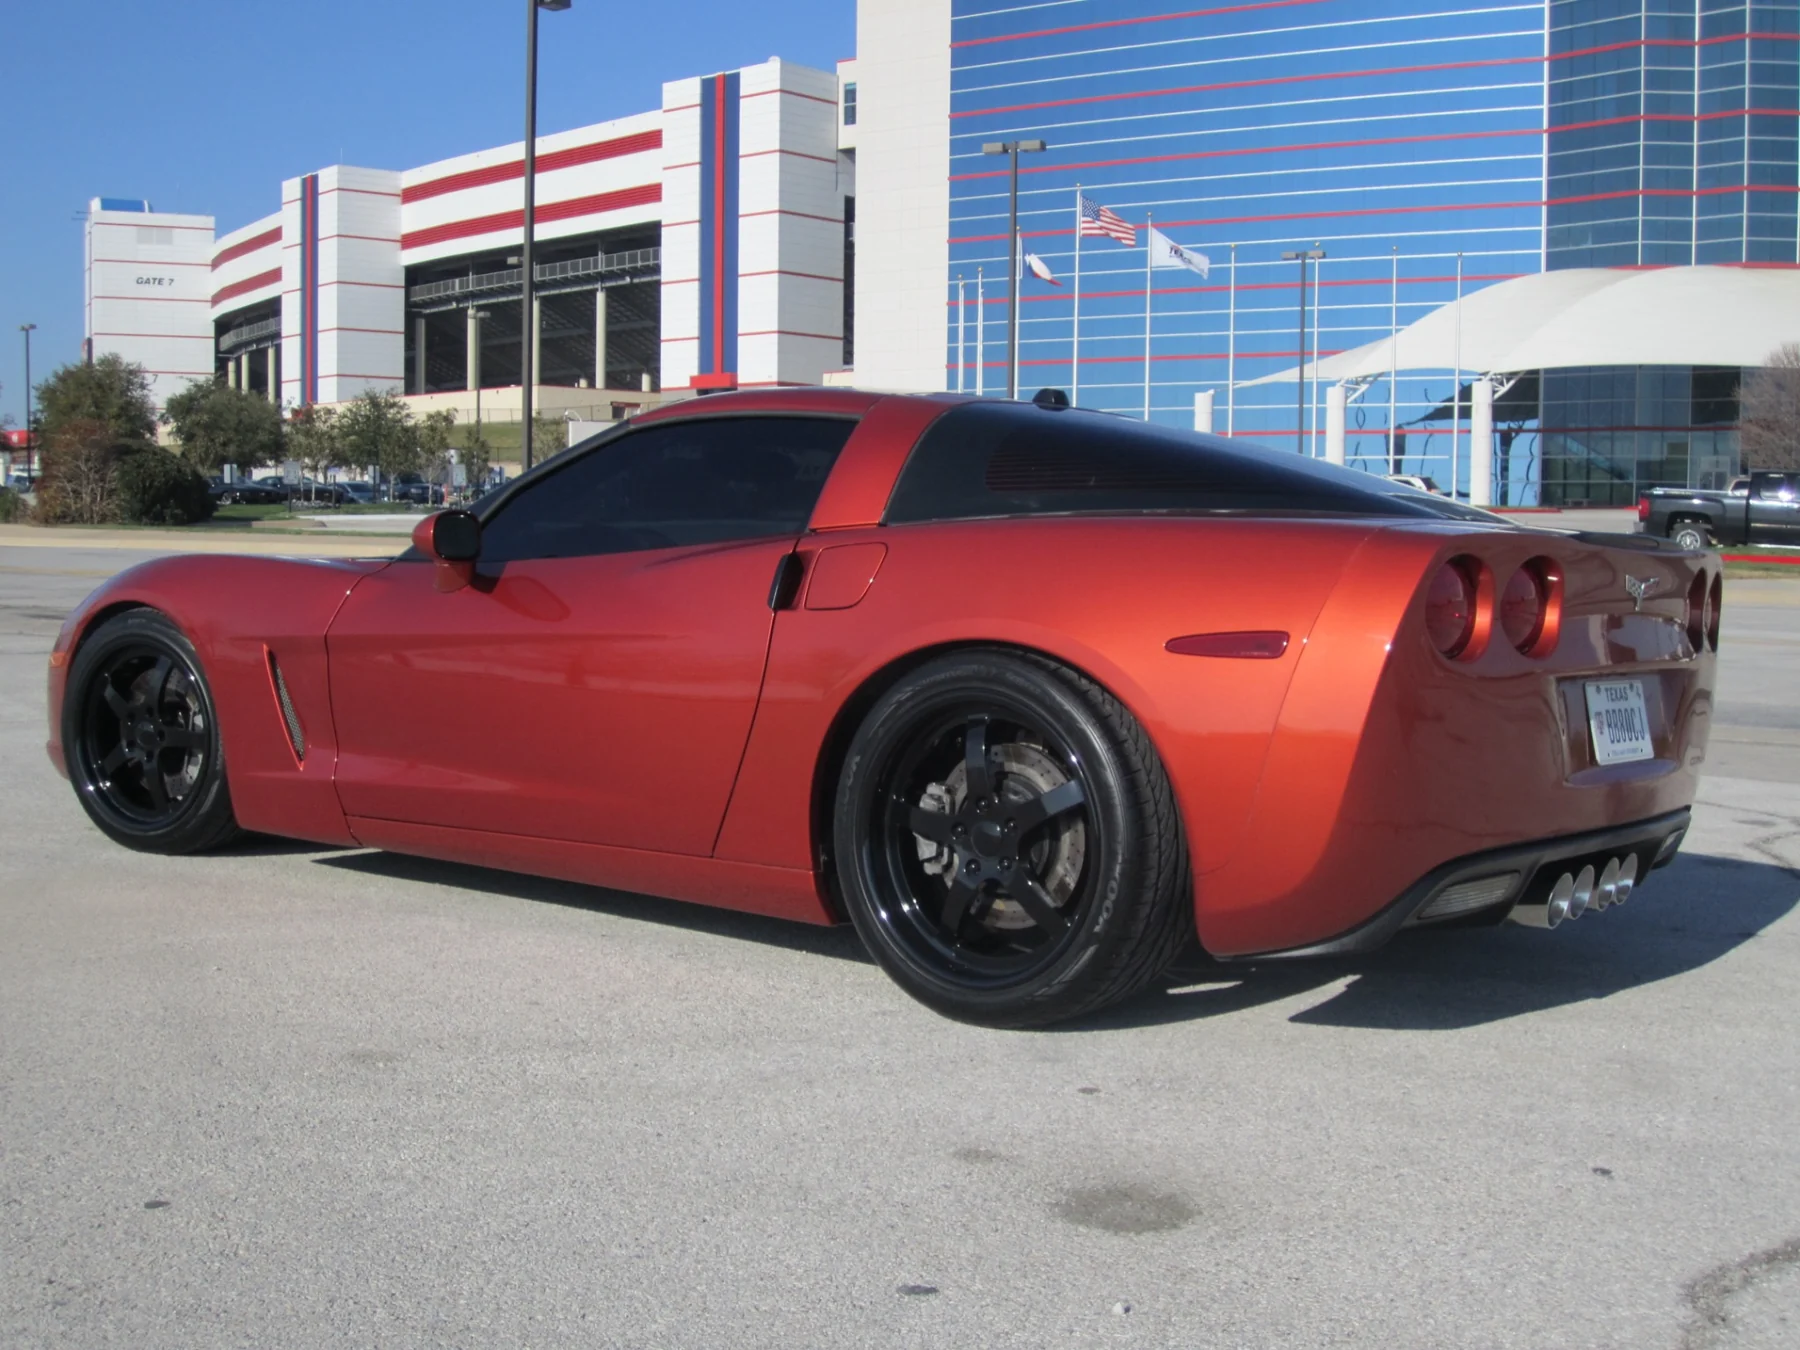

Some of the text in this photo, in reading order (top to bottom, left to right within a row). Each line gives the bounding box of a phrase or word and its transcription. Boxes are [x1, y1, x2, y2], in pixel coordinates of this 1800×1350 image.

[136, 277, 175, 286] GATE 7
[1604, 686, 1629, 702] TEXAS
